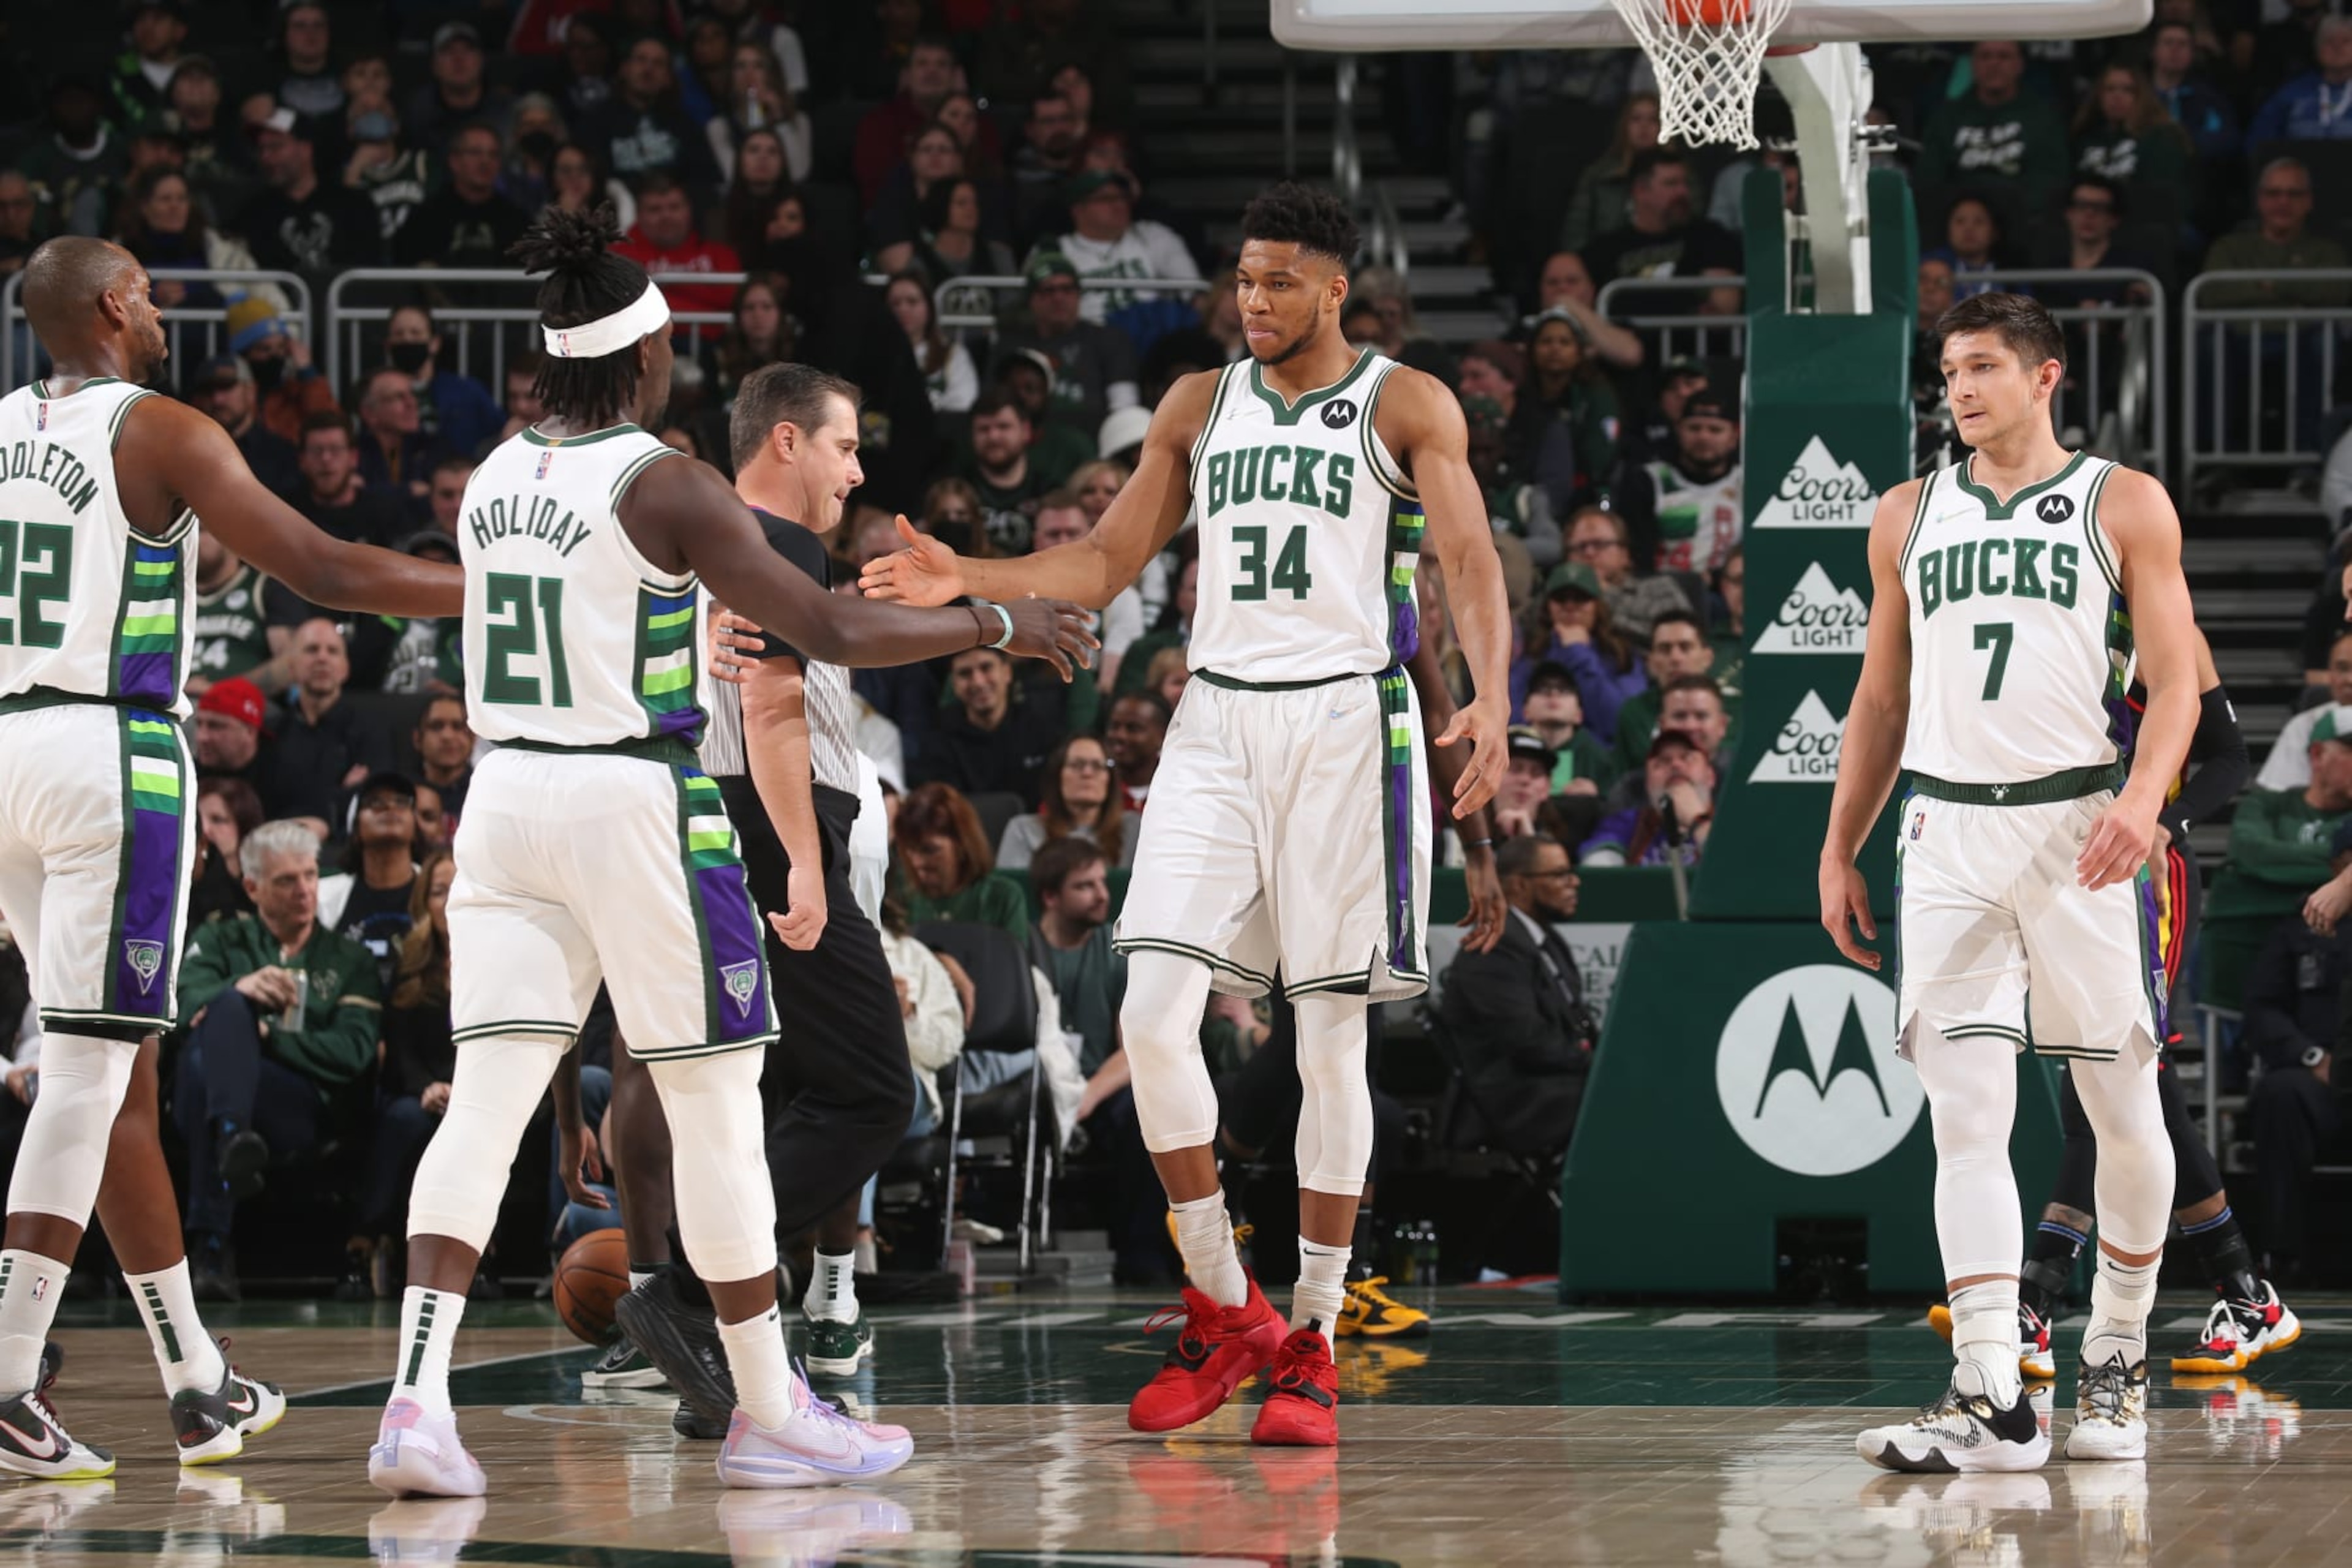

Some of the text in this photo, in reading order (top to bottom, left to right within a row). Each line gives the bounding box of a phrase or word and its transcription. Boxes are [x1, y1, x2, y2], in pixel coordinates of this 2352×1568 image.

[1208, 445, 1355, 519] BUCKS
[1777, 466, 1870, 502] Coors
[1793, 503, 1856, 520] LIGHT
[469, 494, 591, 557] HOLIDAY
[1231, 525, 1312, 601] 34
[1918, 538, 2079, 621] BUCKS
[483, 572, 573, 707] 21
[1792, 630, 1855, 646] LIGHT
[1973, 622, 2014, 701] 7
[1775, 720, 1842, 755] Coo
